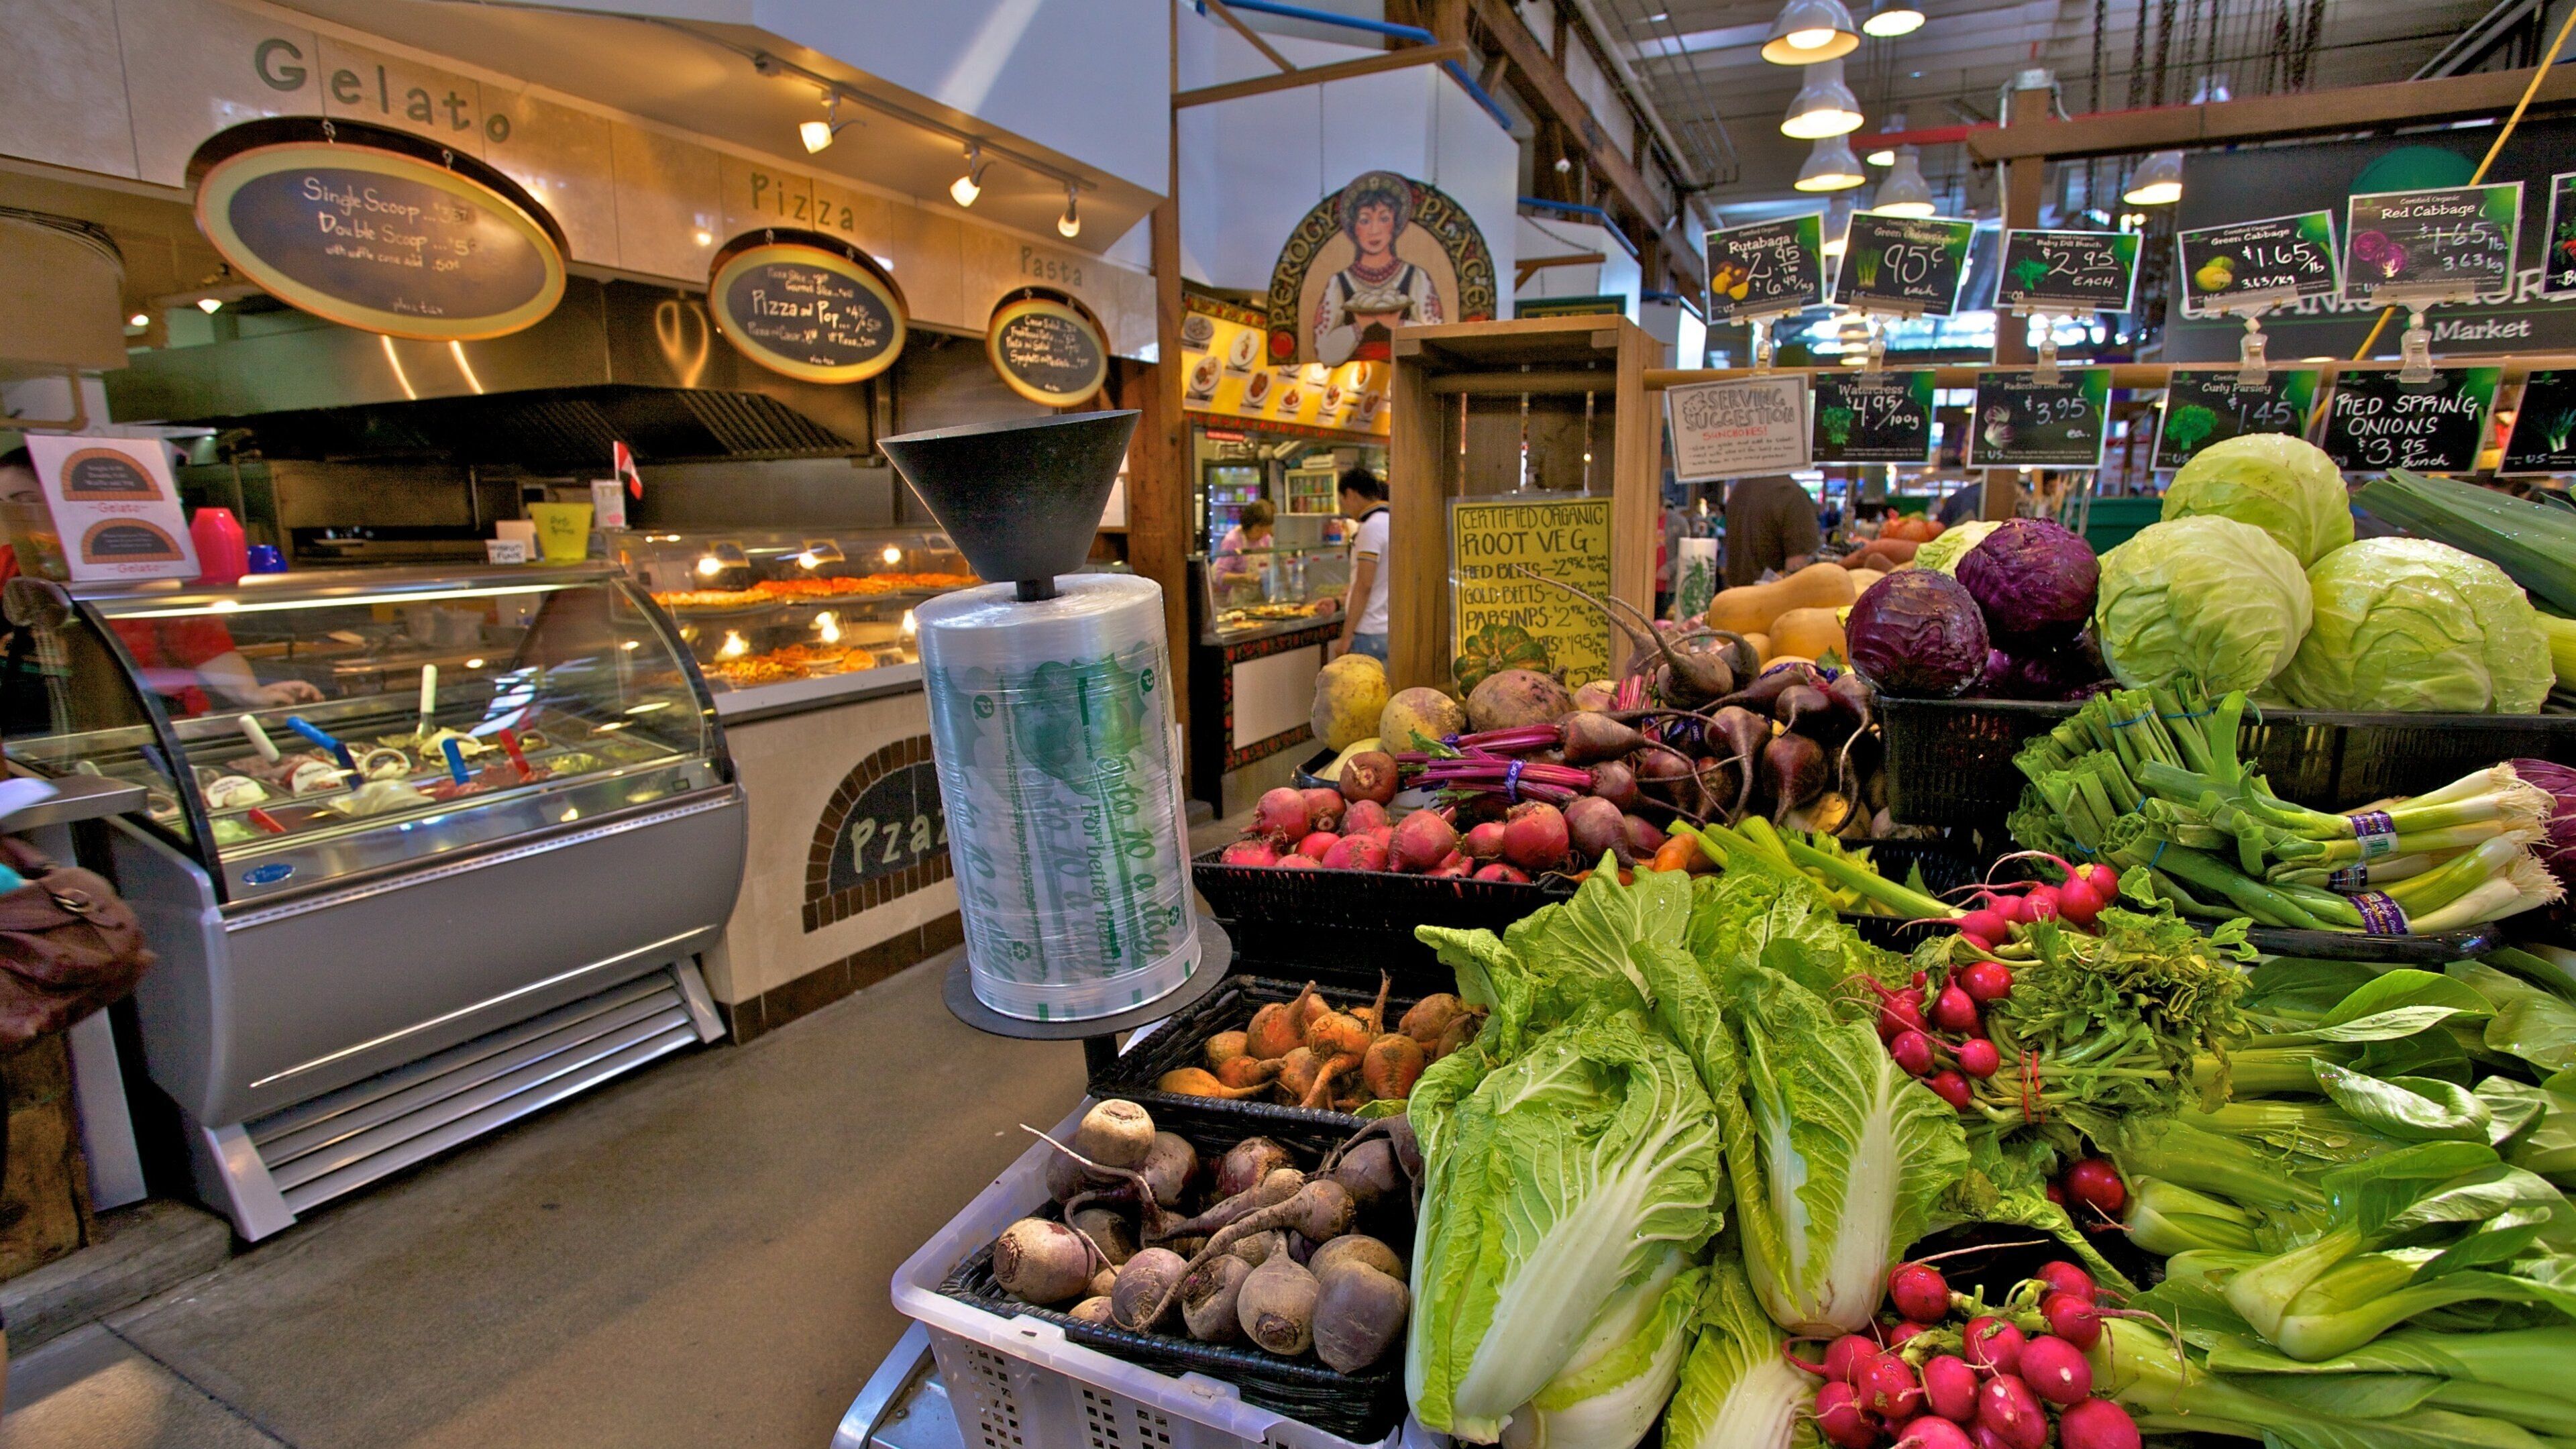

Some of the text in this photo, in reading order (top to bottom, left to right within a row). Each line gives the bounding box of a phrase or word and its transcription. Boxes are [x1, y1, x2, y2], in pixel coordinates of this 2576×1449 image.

[255, 39, 510, 143] Gelato
[303, 176, 420, 225] Single Scoop
[751, 172, 853, 231] Pizza
[2381, 204, 2475, 219] Red Cabbage
[318, 211, 428, 252] Double Scoop
[1874, 227, 1902, 237] Green
[2037, 239, 2058, 248] Baby
[2211, 229, 2290, 246] Green Cabbage
[1729, 235, 1790, 254] Rutabaga
[1021, 246, 1081, 286] Pasta
[1741, 246, 1800, 281] $2.95
[2442, 253, 2504, 274] 3.63 kg
[1904, 284, 1938, 297] each
[751, 289, 798, 317] Pizza
[2434, 320, 2531, 342] Market
[1708, 388, 1785, 410] SERVING
[1838, 384, 1904, 395] Watercress
[2202, 382, 2271, 394] Curly Parsley
[2025, 395, 2088, 425] $3.95
[2227, 394, 2292, 434] $1.45
[2336, 392, 2479, 421] RED SPRING
[1684, 407, 1794, 432] SUGGESTION
[2348, 417, 2438, 435] ONIONS
[1987, 450, 2004, 460] US
[2526, 453, 2547, 463] US
[1462, 506, 1603, 529] CERTIFIED ORGANIC
[1464, 531, 1528, 556] ROOT
[1464, 565, 1493, 579] RED
[1464, 588, 1499, 604] GOLD
[1106, 780, 1148, 818] to
[1120, 826, 1157, 863] 10
[967, 837, 997, 882] 10
[1077, 800, 1125, 979] For better health
[1132, 871, 1159, 895] a
[976, 883, 999, 911] a
[1126, 898, 1173, 962] day
